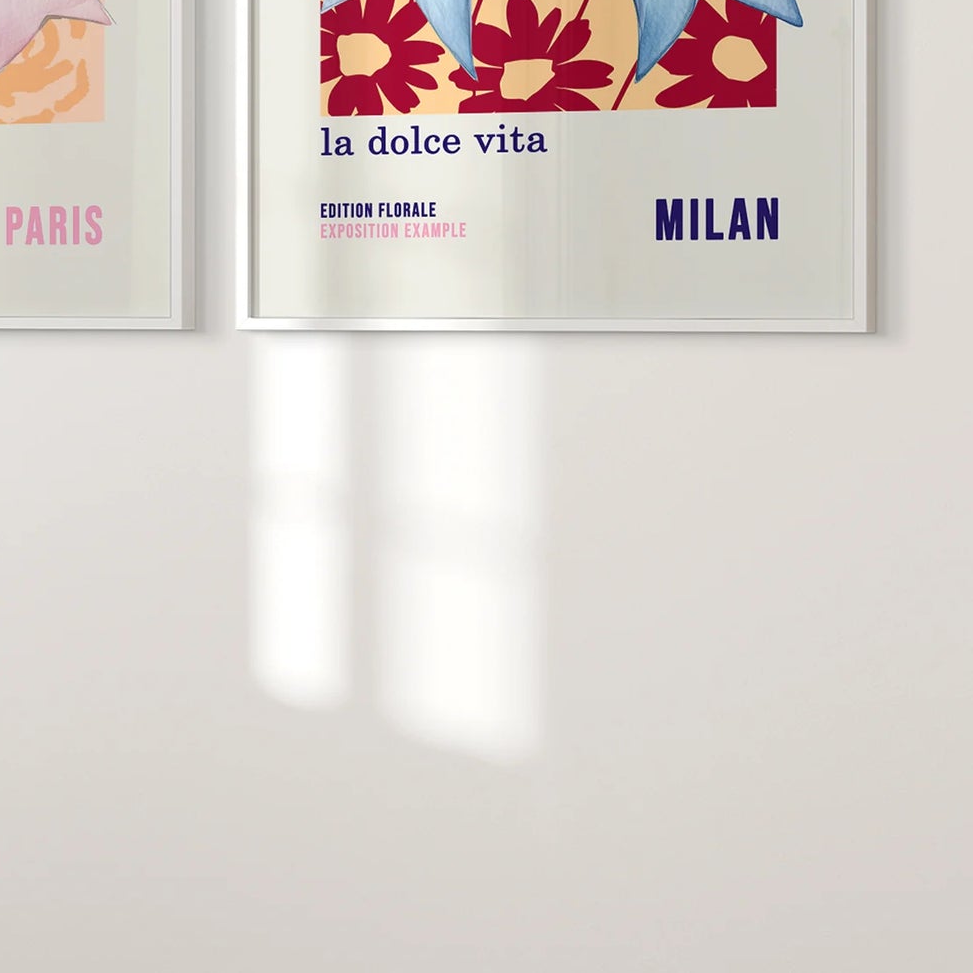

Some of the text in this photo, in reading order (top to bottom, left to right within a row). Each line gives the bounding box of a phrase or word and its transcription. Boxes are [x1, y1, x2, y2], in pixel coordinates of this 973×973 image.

[321, 124, 547, 156] la dolce vita
[6, 205, 103, 246] PARIS
[321, 202, 436, 218] EDITION FLORALE
[656, 197, 779, 241] MILAN
[321, 222, 467, 238] EXPOSITION EXAMPLE
